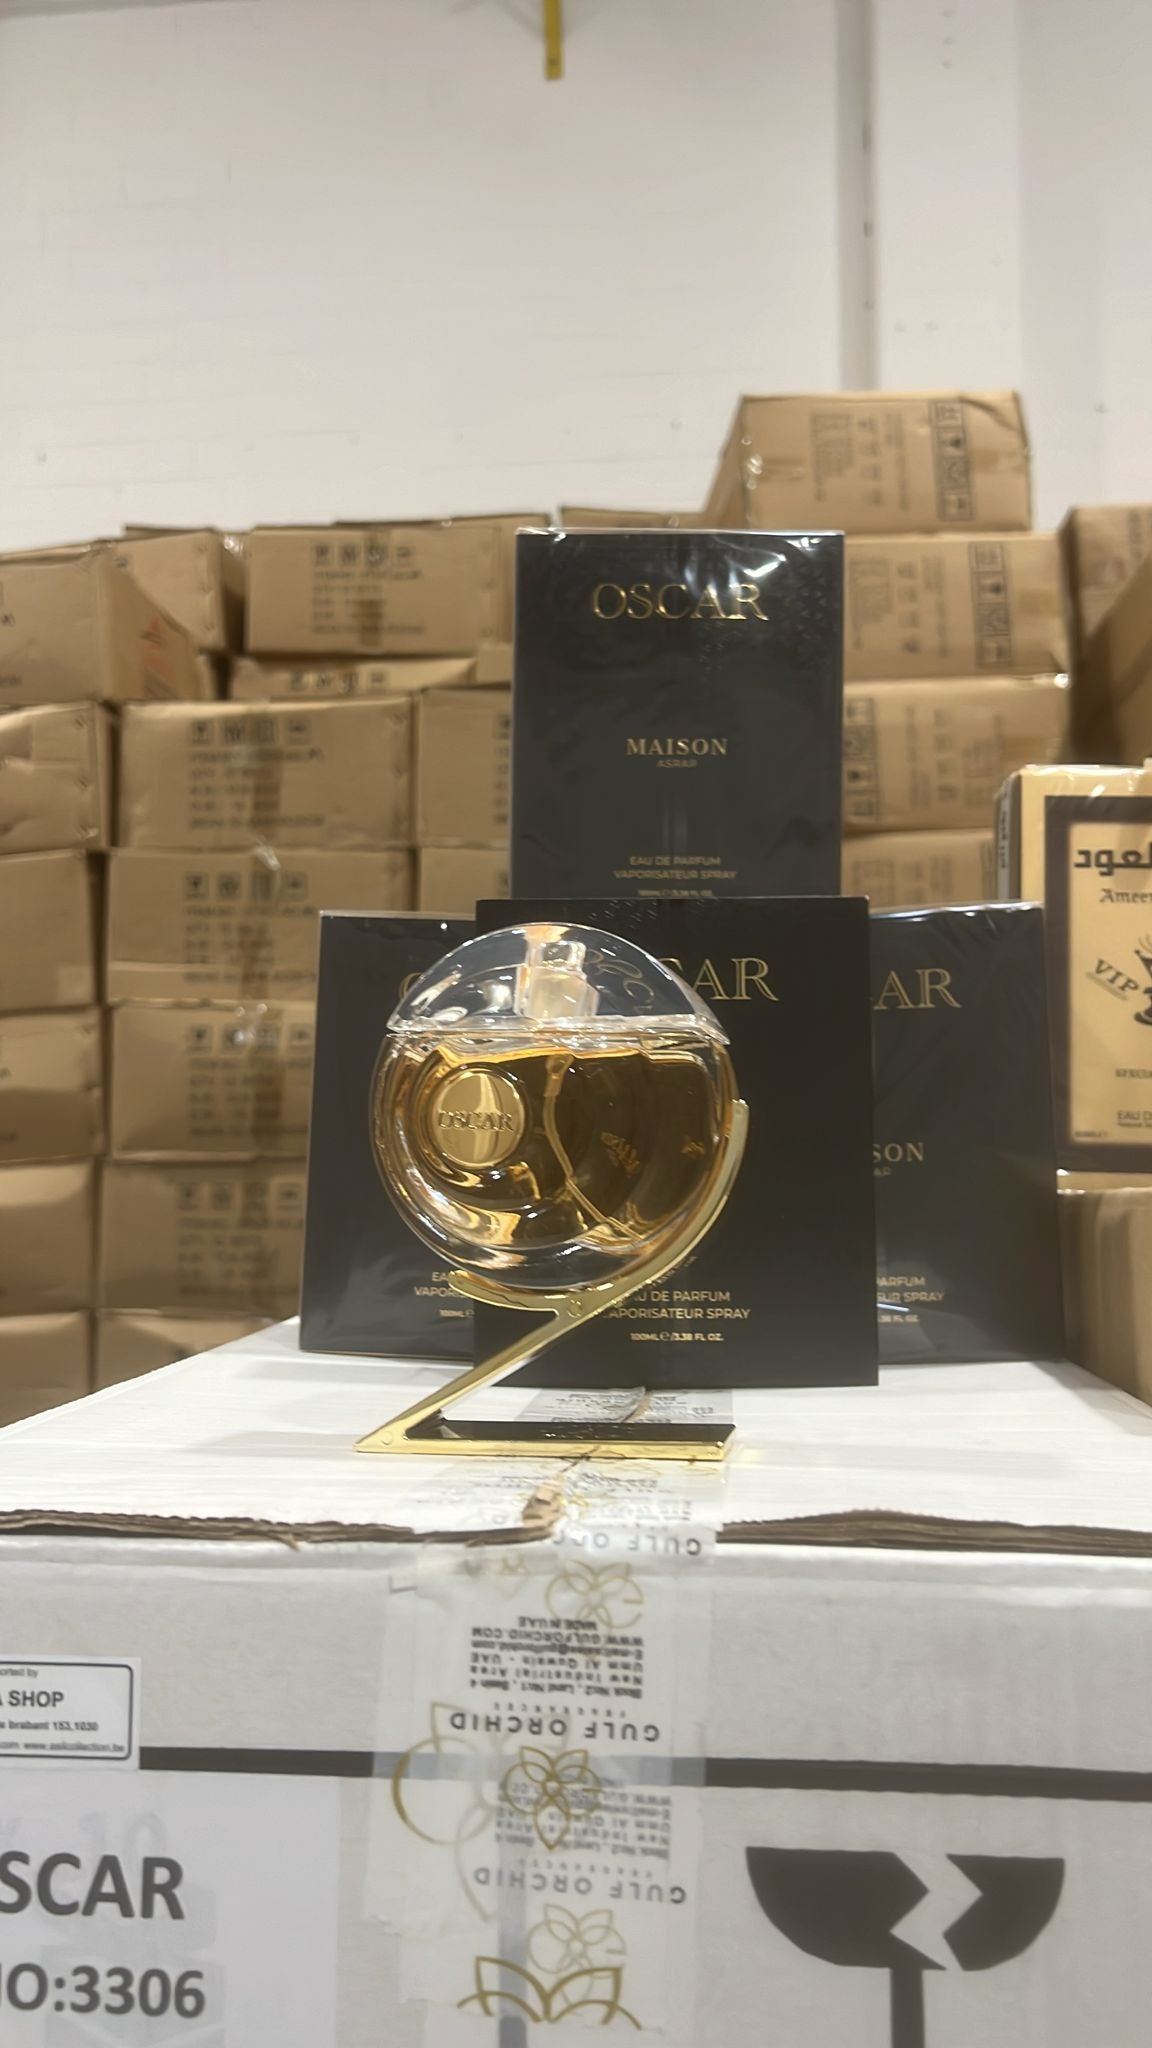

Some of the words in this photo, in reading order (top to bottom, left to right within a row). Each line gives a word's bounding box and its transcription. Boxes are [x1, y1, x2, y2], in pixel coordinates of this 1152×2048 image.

[593, 583, 769, 621] OSCAR
[626, 739, 727, 755] MAISON
[629, 856, 653, 866] EAU
[655, 856, 671, 866] DE
[673, 856, 721, 866] PARFUM
[700, 870, 737, 879] SPRAY
[1094, 958, 1140, 991] VIP
[438, 1109, 514, 1132] OSCAR
[432, 1271, 449, 1281] EA
[651, 1291, 670, 1301] DE
[673, 1291, 730, 1301] PARFUM
[903, 1291, 945, 1303] SPRAY
[604, 1308, 703, 1319] APORISATEUR
[706, 1308, 750, 1319] SPRAY
[628, 1535, 701, 1555] GULF
[471, 1653, 501, 1664] UAE
[470, 1666, 508, 1677] Area
[516, 1669, 601, 1683] Industrial
[8, 1690, 64, 1707] SHOP
[449, 1712, 567, 1737] ORCHID
[584, 1722, 660, 1742] GULF
[473, 1868, 592, 1894] ORCHID
[608, 1880, 686, 1904] GULF
[0, 1963, 206, 2020] O:3306
